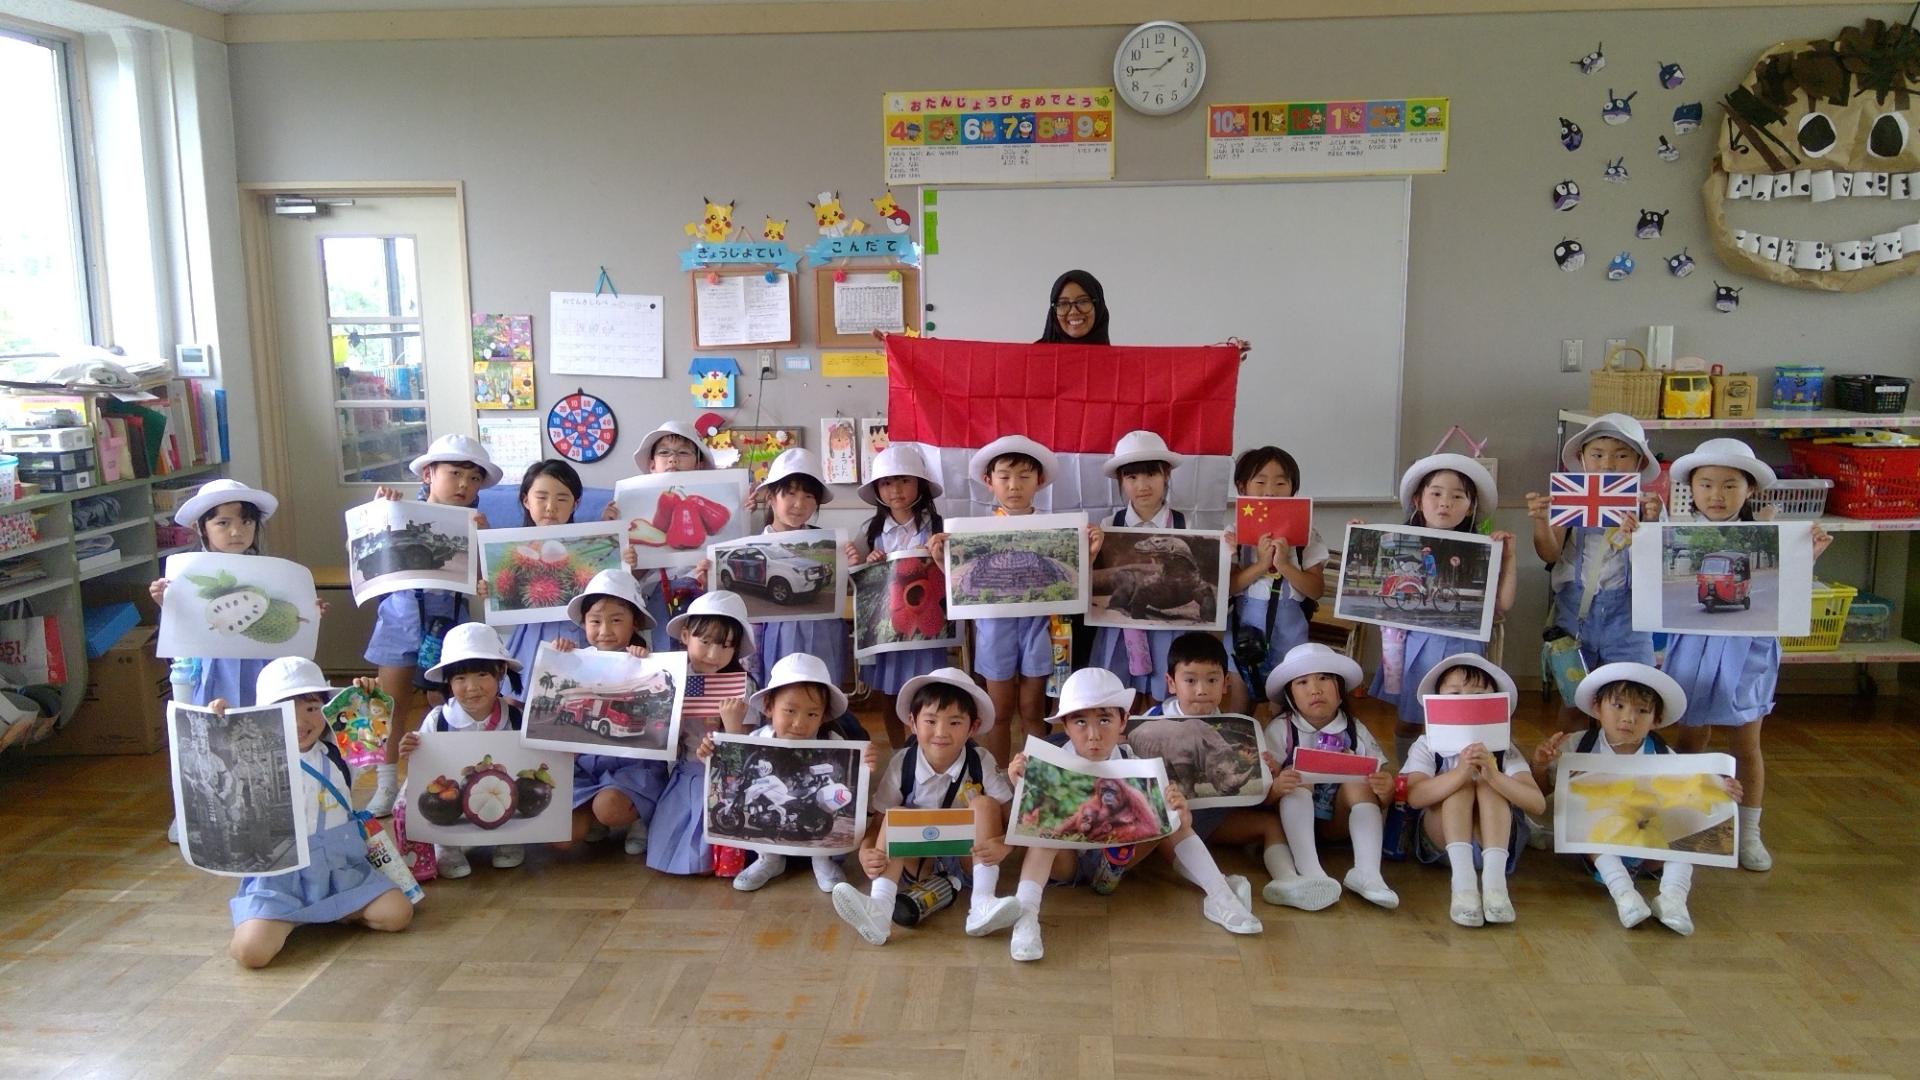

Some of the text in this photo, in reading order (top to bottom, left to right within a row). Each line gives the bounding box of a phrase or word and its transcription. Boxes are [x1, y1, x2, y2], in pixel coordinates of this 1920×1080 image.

[1141, 37, 1149, 48] 11
[1155, 33, 1166, 45] 12
[1131, 49, 1141, 61] 10
[1182, 46, 1189, 58] 2
[1126, 65, 1134, 78] 9
[1186, 62, 1194, 74] 3
[1132, 81, 1140, 92] 8
[1181, 78, 1188, 89] 4
[910, 95, 1013, 112] おたんじょうび
[1020, 94, 1092, 110] おめでとう
[1142, 91, 1149, 103] 7
[1156, 93, 1164, 105] 6
[1171, 89, 1178, 101] 5
[1212, 111, 1233, 134] 10
[1251, 110, 1270, 132] 11
[1291, 109, 1311, 131] 12
[1331, 108, 1341, 131] 1
[1410, 106, 1426, 128] 3
[890, 120, 907, 141] 4
[927, 121, 945, 141] 5
[964, 119, 980, 140] 6
[1003, 118, 1018, 140] 7
[1038, 117, 1055, 139] 8
[1077, 116, 1094, 138] 9
[831, 240, 898, 254] こんだて
